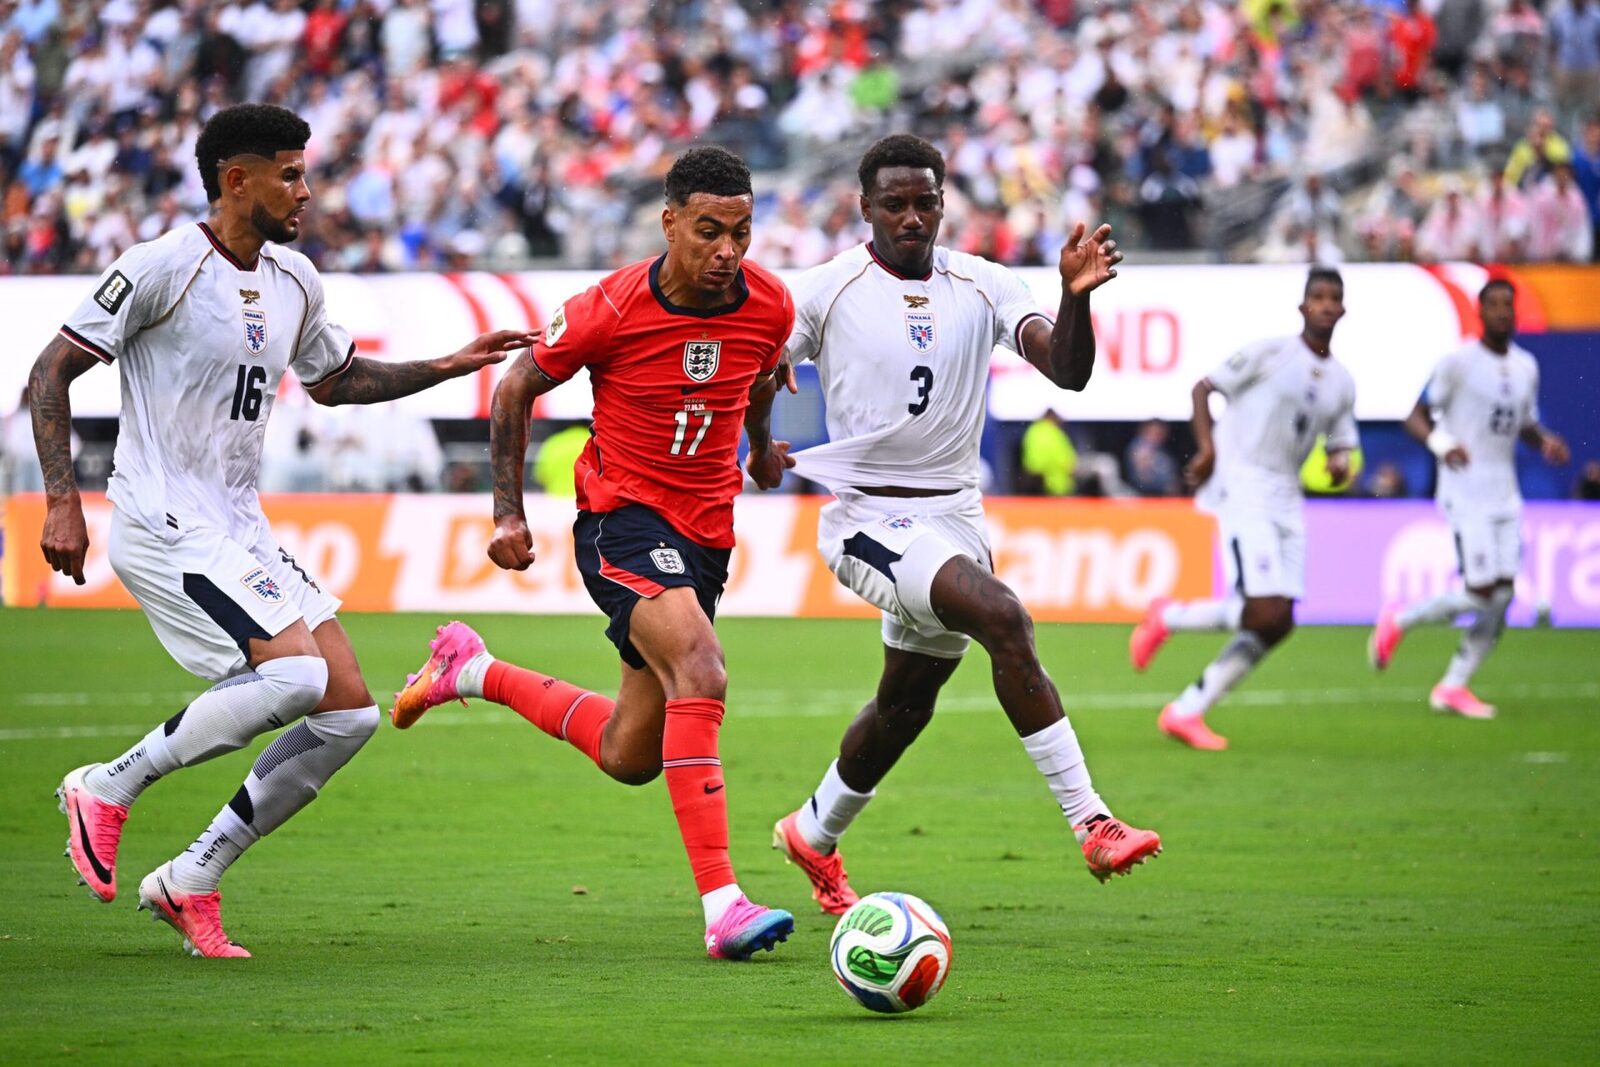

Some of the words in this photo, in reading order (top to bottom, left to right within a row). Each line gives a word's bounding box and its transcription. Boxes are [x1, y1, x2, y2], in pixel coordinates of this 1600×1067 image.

[229, 364, 267, 422] 16
[908, 365, 934, 417] 3
[670, 409, 714, 456] 17
